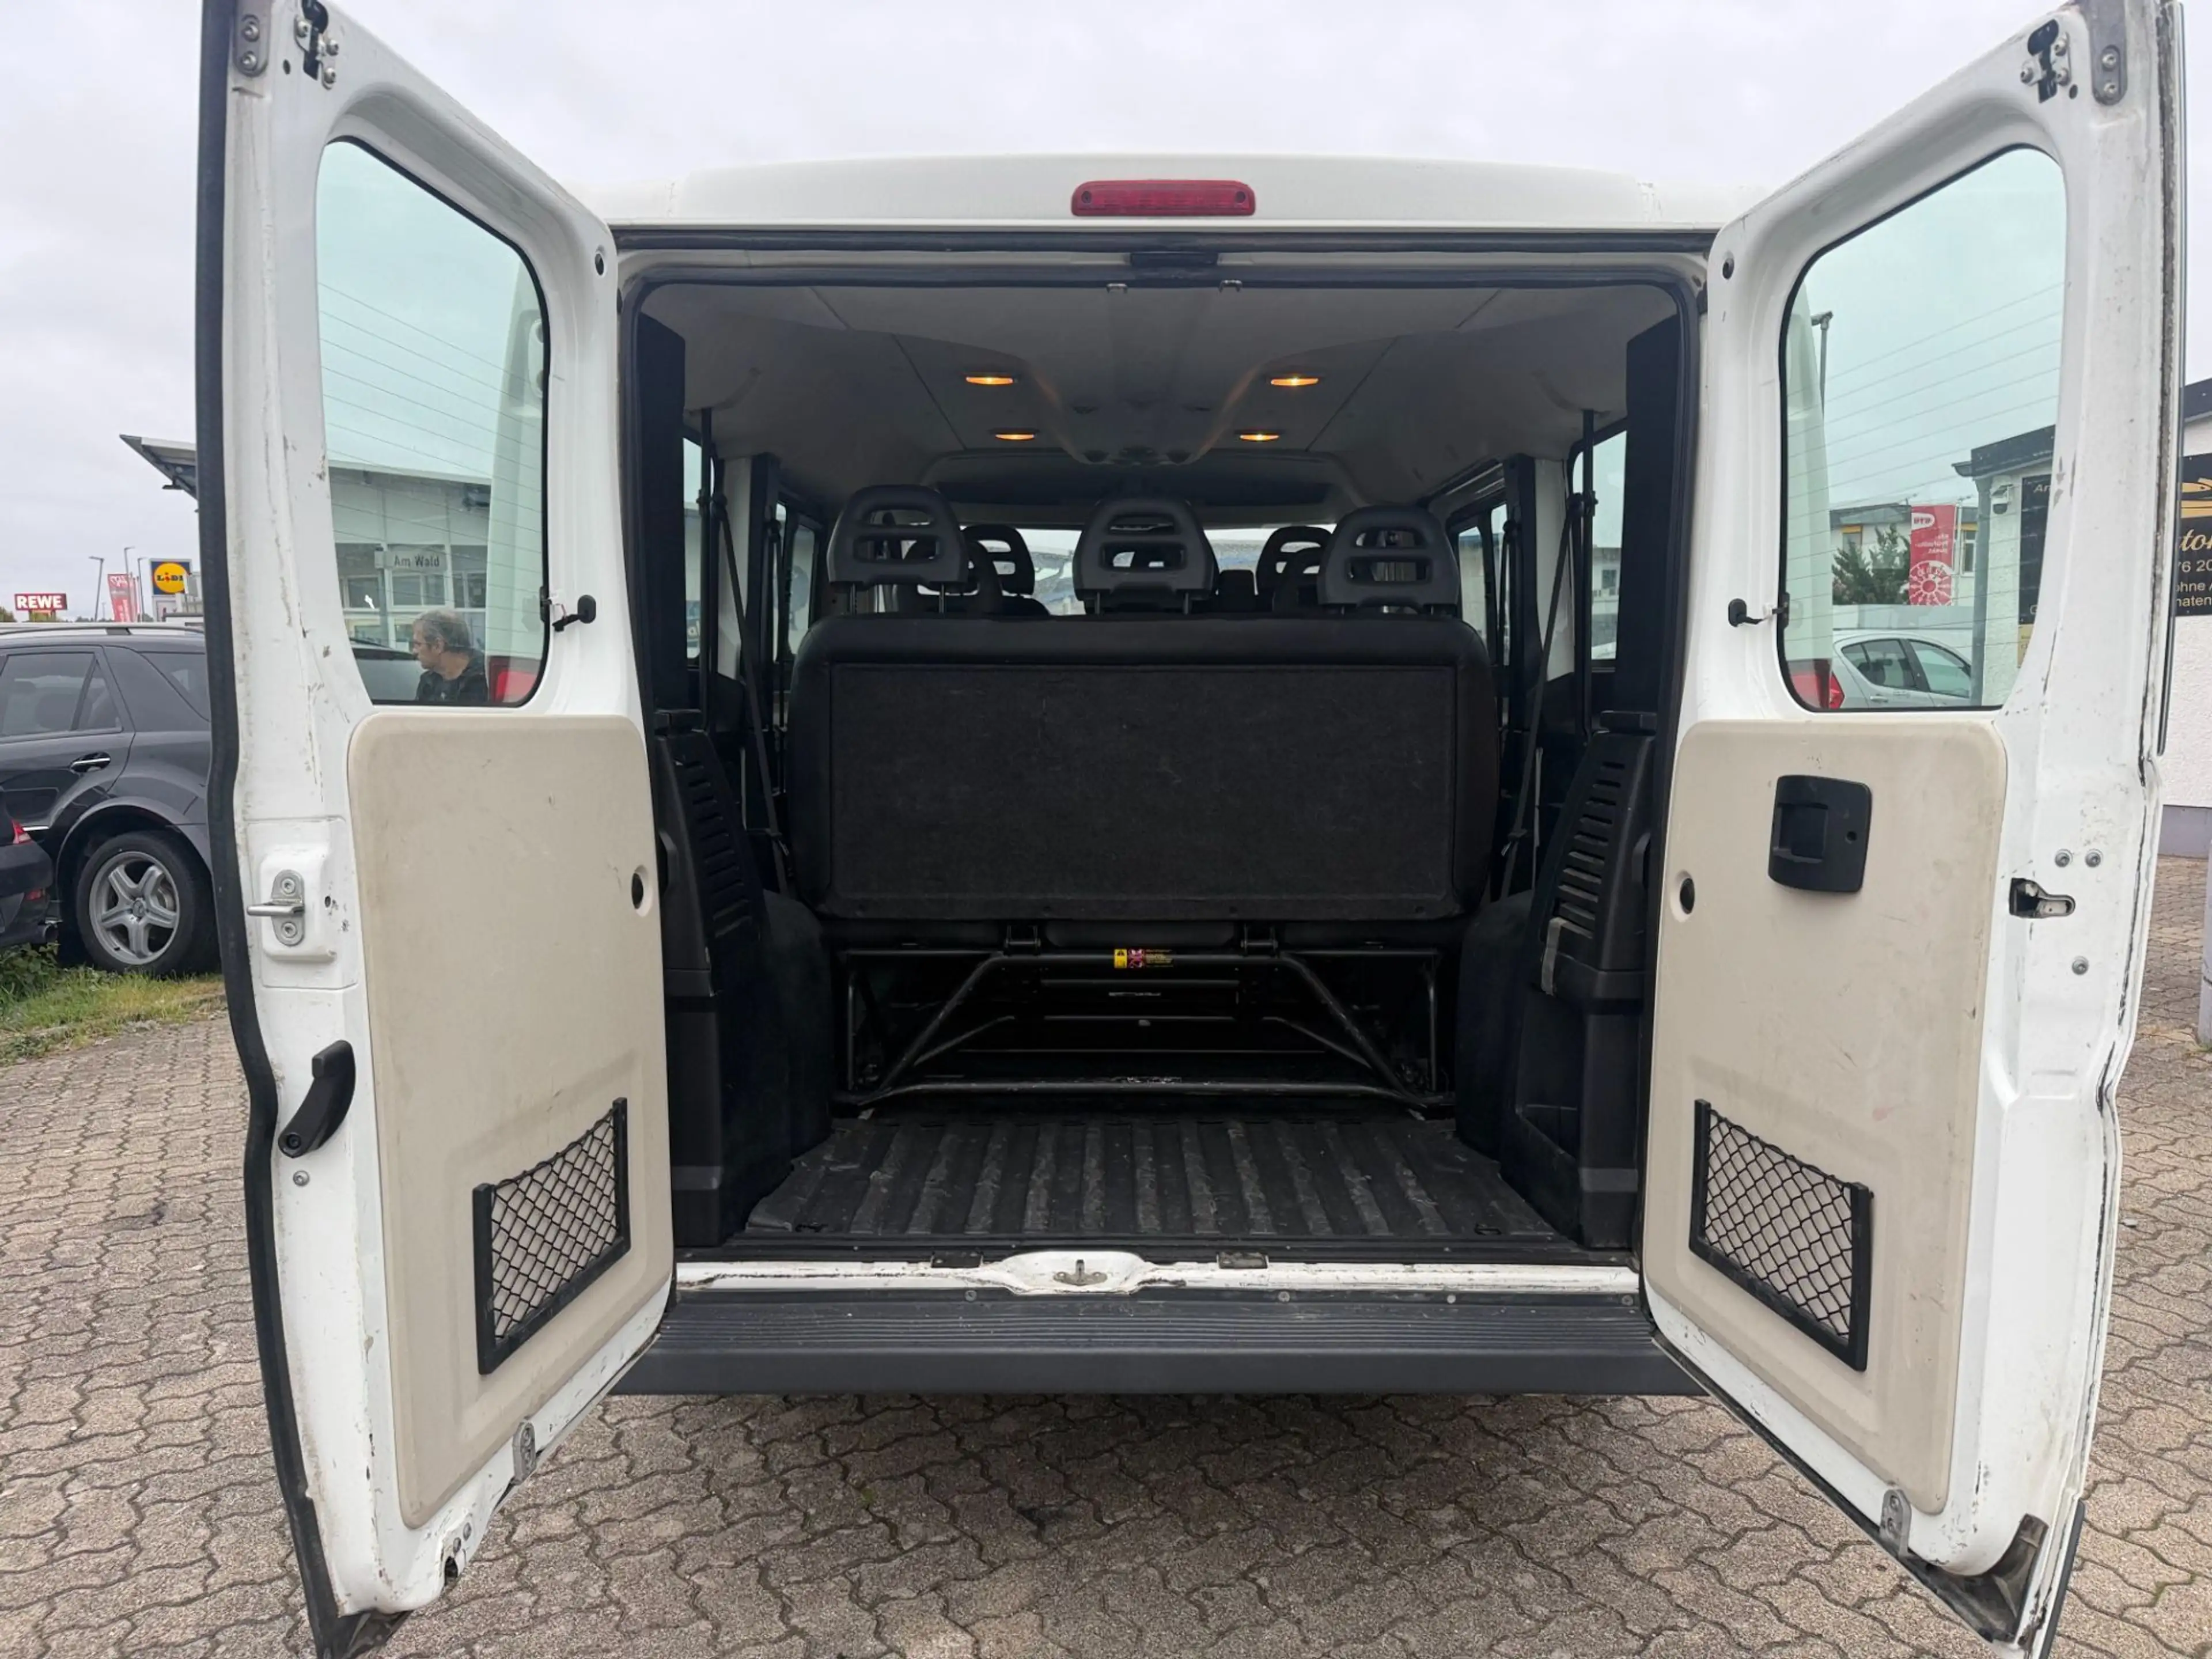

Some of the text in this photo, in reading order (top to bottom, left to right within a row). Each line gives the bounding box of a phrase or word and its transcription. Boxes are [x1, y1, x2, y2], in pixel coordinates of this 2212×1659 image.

[395, 554, 440, 567] Am Wald
[17, 595, 63, 609] REWE
